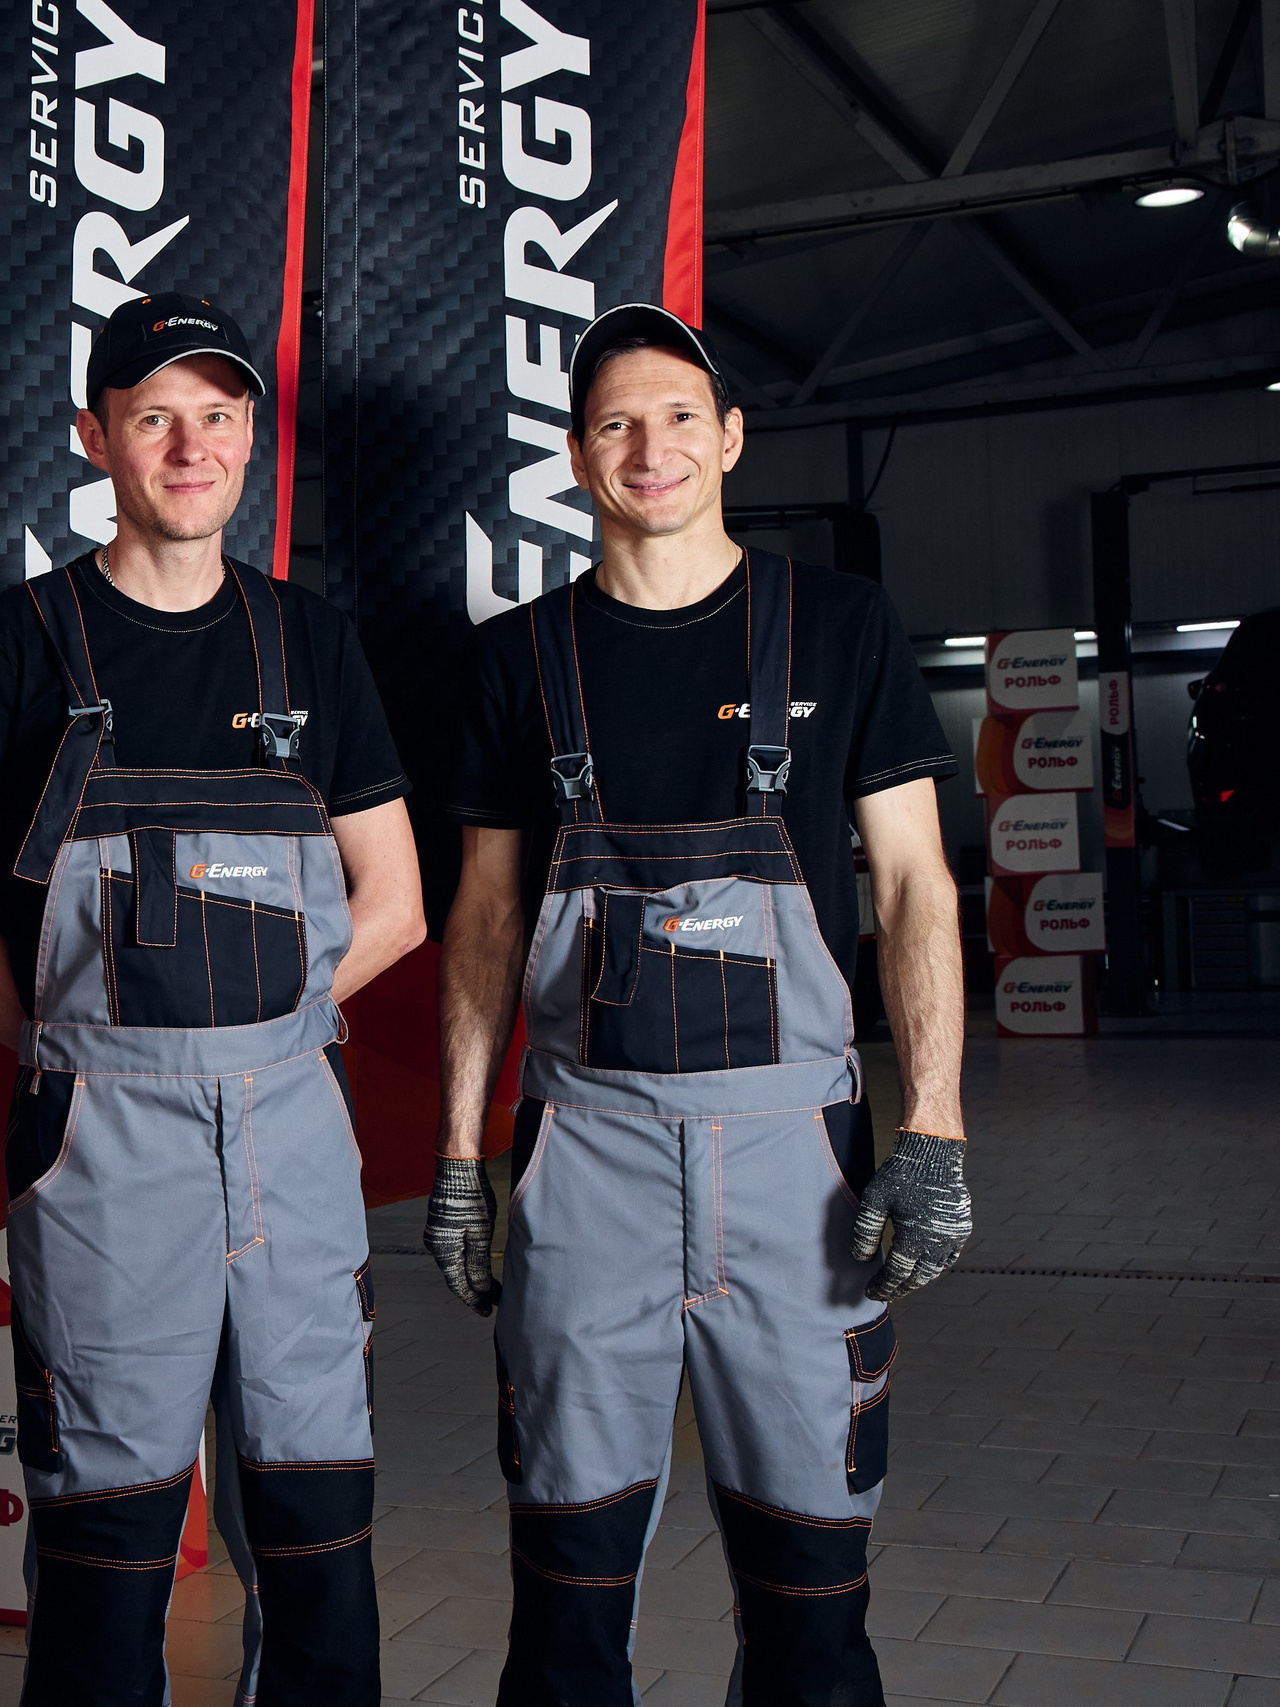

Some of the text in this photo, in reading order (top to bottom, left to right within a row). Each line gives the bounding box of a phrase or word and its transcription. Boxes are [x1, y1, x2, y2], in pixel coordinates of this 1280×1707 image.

[458, 0, 486, 209] SERVIC
[1004, 675, 1061, 688] РОЛЬФ
[1028, 756, 1078, 768] РОЛЬФ
[1005, 838, 1062, 851] РОЛЬФ
[1040, 918, 1090, 930] РОЛЬФ
[1010, 1001, 1066, 1012] РОЛЬФ
